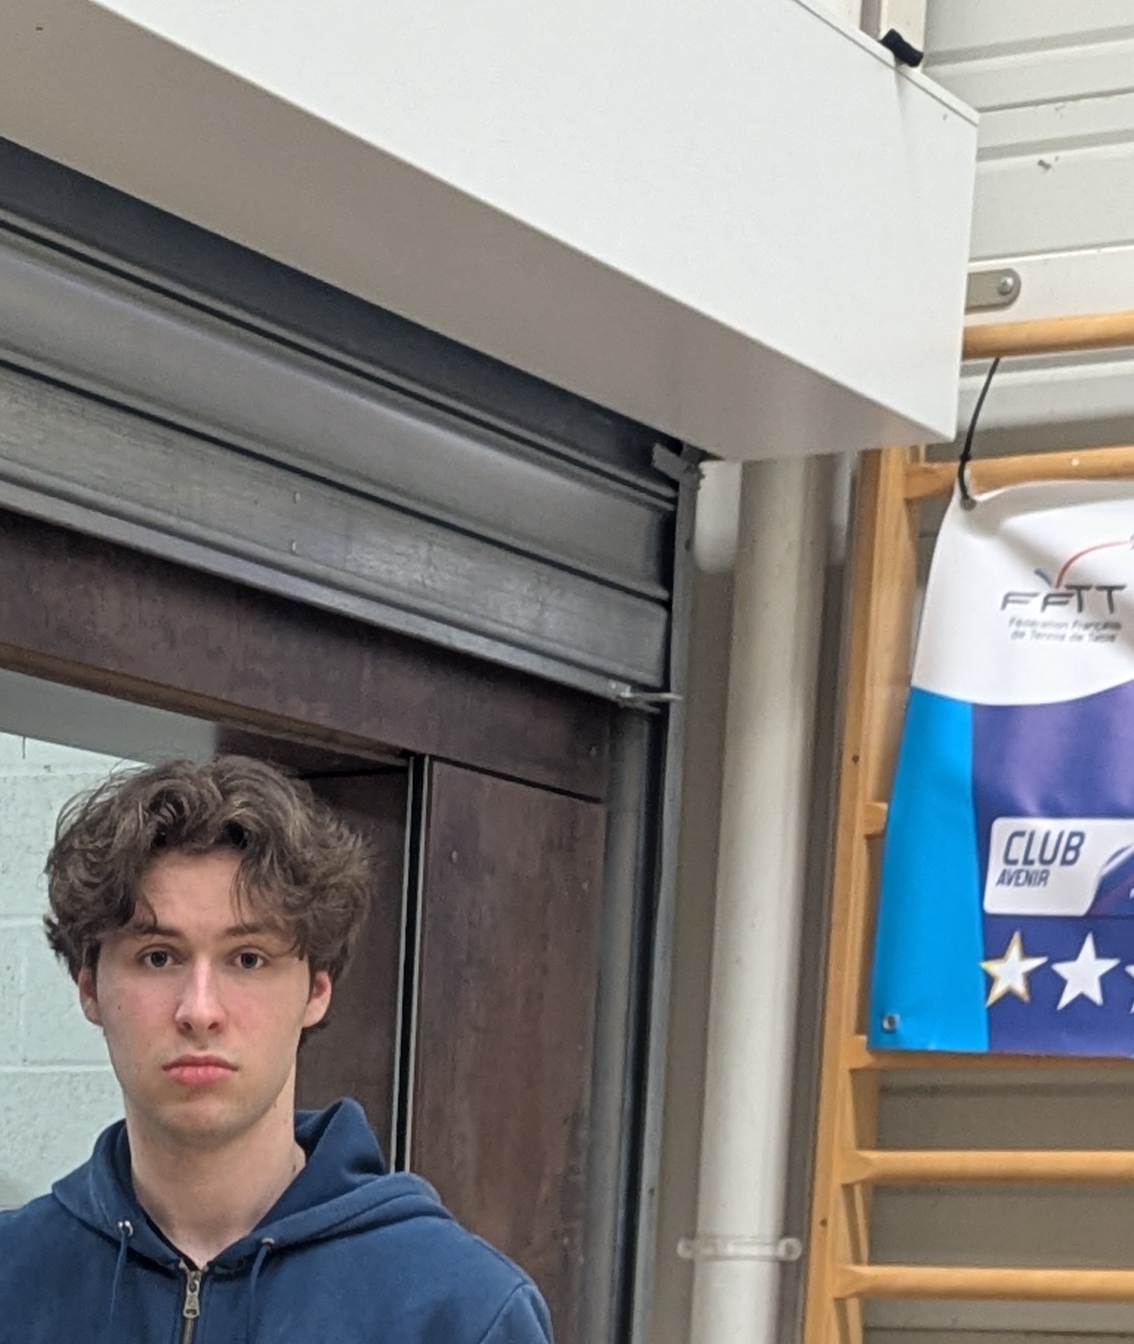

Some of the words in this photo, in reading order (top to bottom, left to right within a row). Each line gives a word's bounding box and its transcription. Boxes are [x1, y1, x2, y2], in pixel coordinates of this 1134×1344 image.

[1000, 584, 1127, 614] FFTT
[1003, 830, 1086, 867] CLUB
[995, 869, 1050, 888] AVENIR
